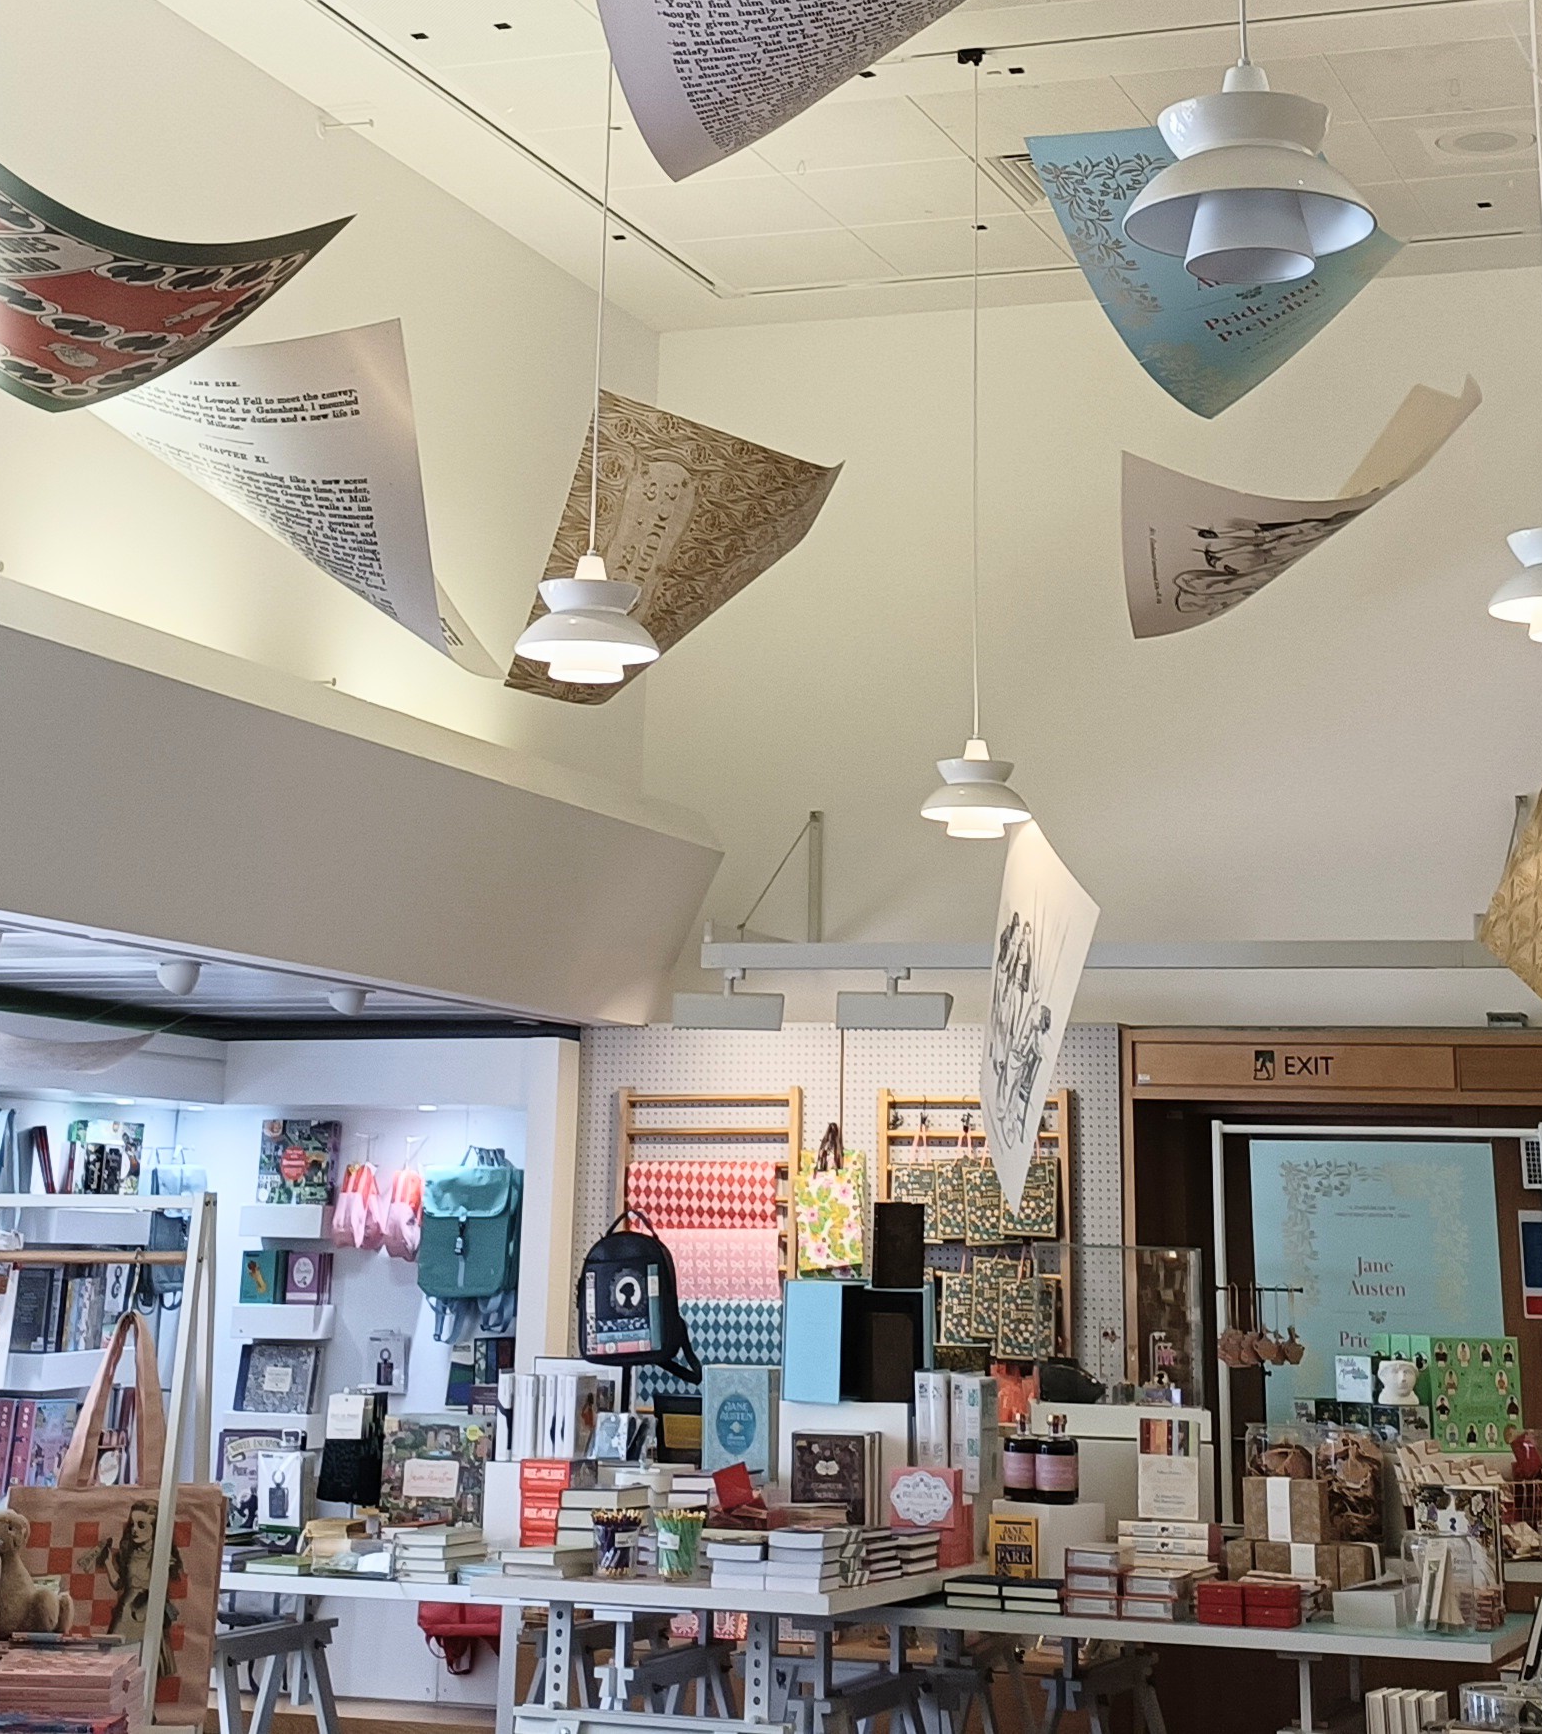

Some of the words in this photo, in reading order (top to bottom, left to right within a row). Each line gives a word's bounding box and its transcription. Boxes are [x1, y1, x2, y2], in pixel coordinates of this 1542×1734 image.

[1204, 304, 1268, 330] Pride
[1284, 1056, 1334, 1076] EXIT
[1353, 1256, 1394, 1278] Jane
[1348, 1280, 1406, 1298] Austen
[723, 1400, 748, 1412] JANE
[997, 1550, 1030, 1564] PARK
